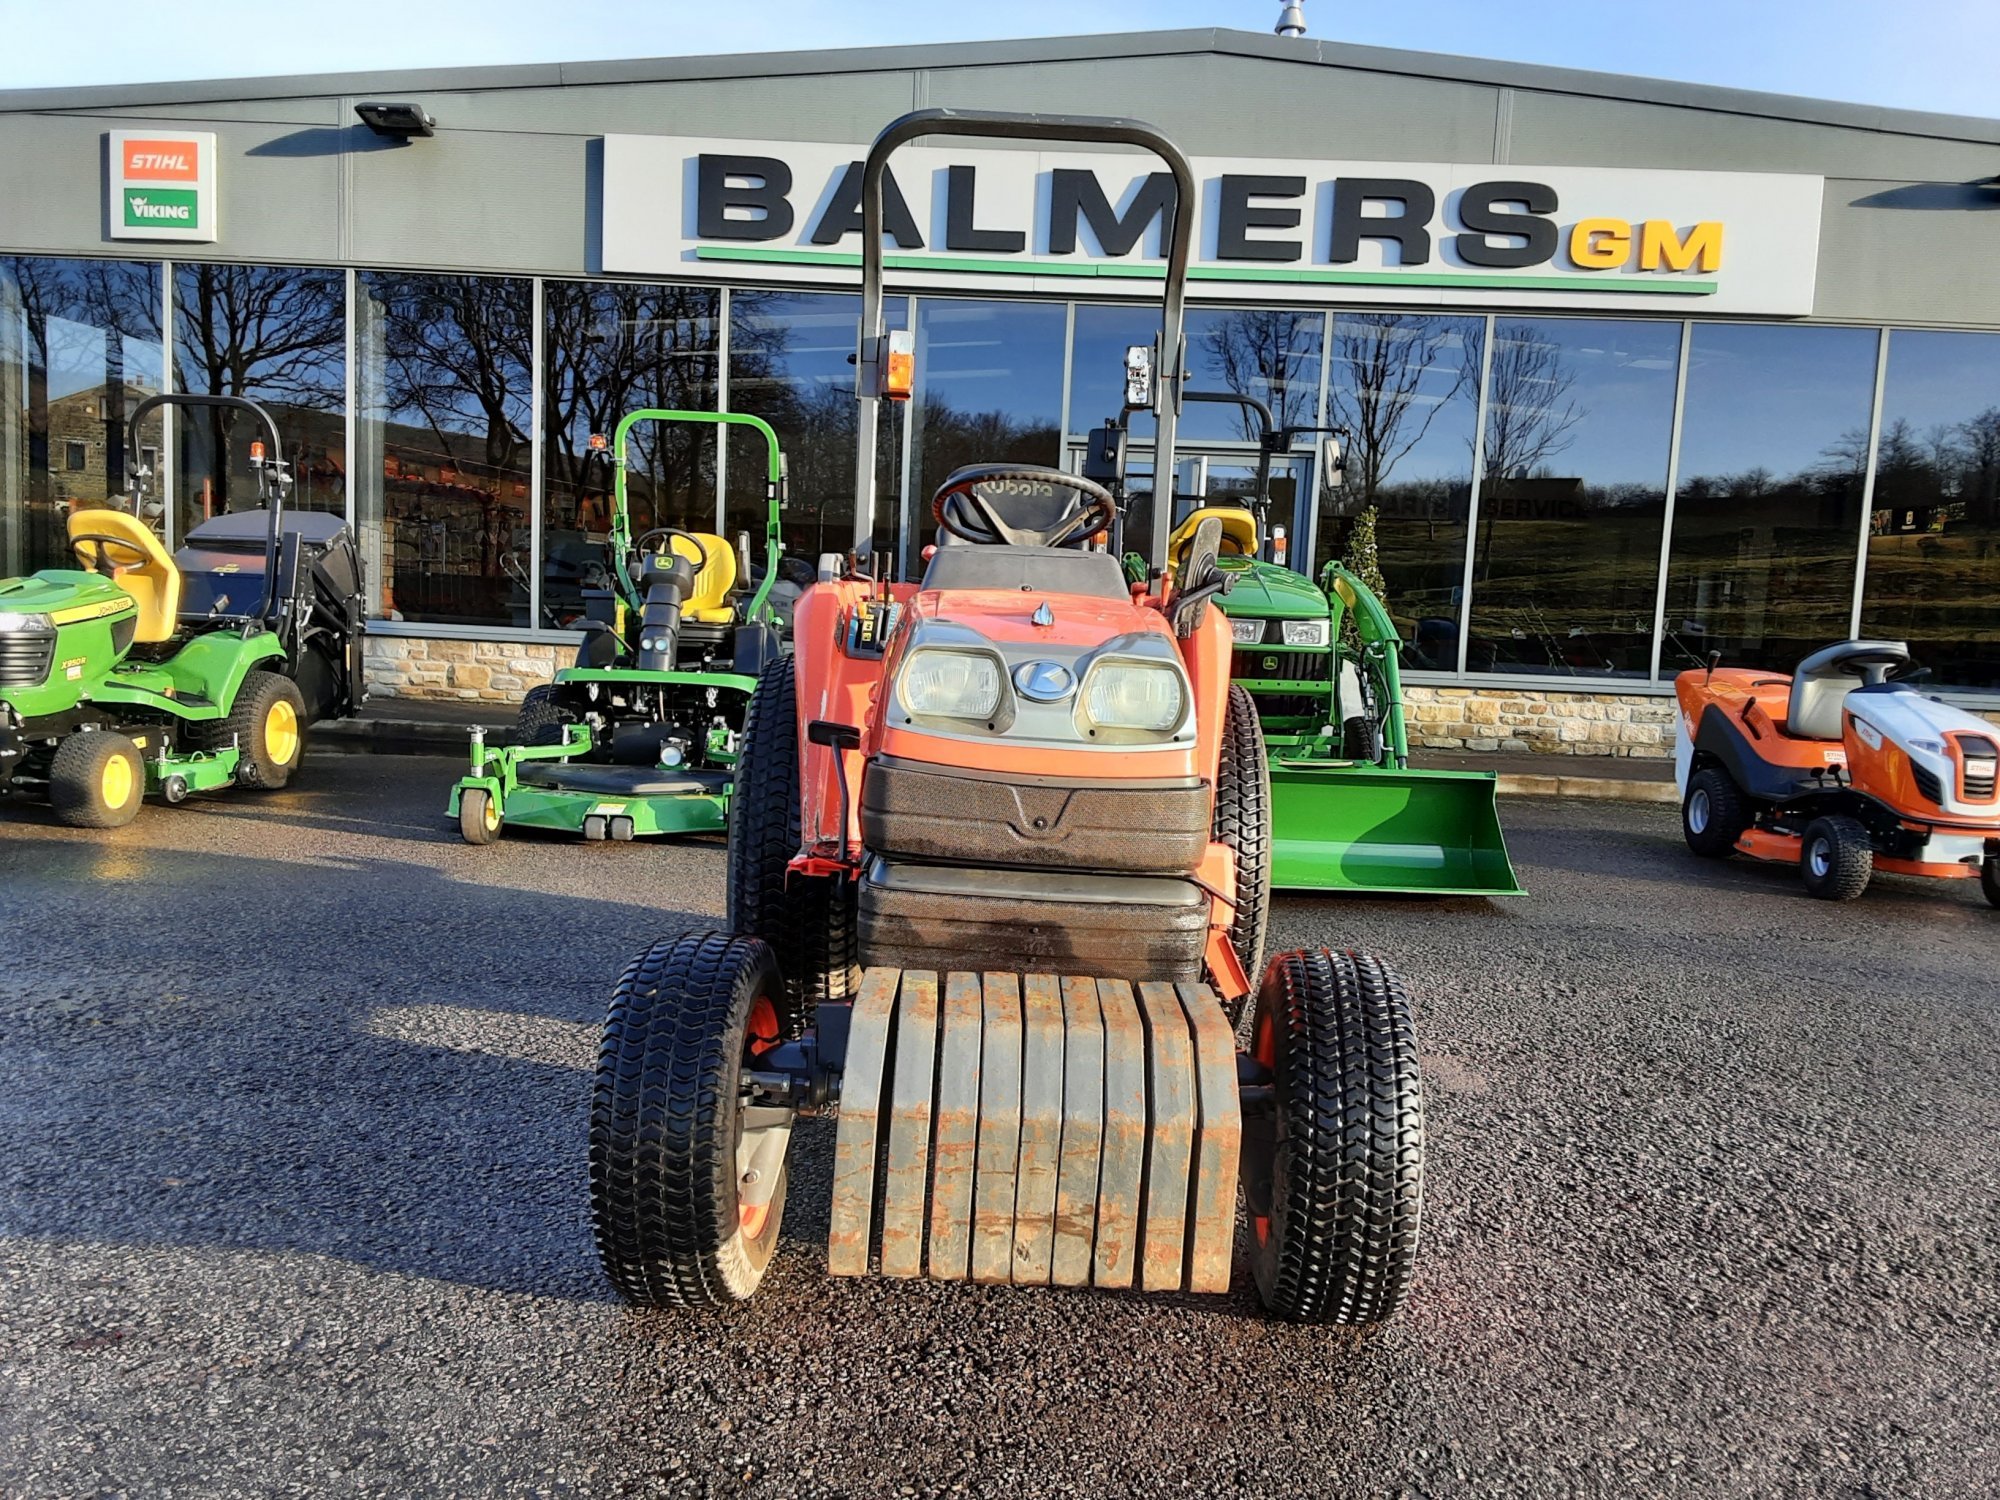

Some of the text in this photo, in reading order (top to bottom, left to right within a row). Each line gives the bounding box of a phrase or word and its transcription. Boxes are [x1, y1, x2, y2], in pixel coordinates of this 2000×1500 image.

[129, 154, 190, 171] STIHL
[131, 203, 190, 219] VIKING
[697, 152, 1724, 273] BALMERS GM
